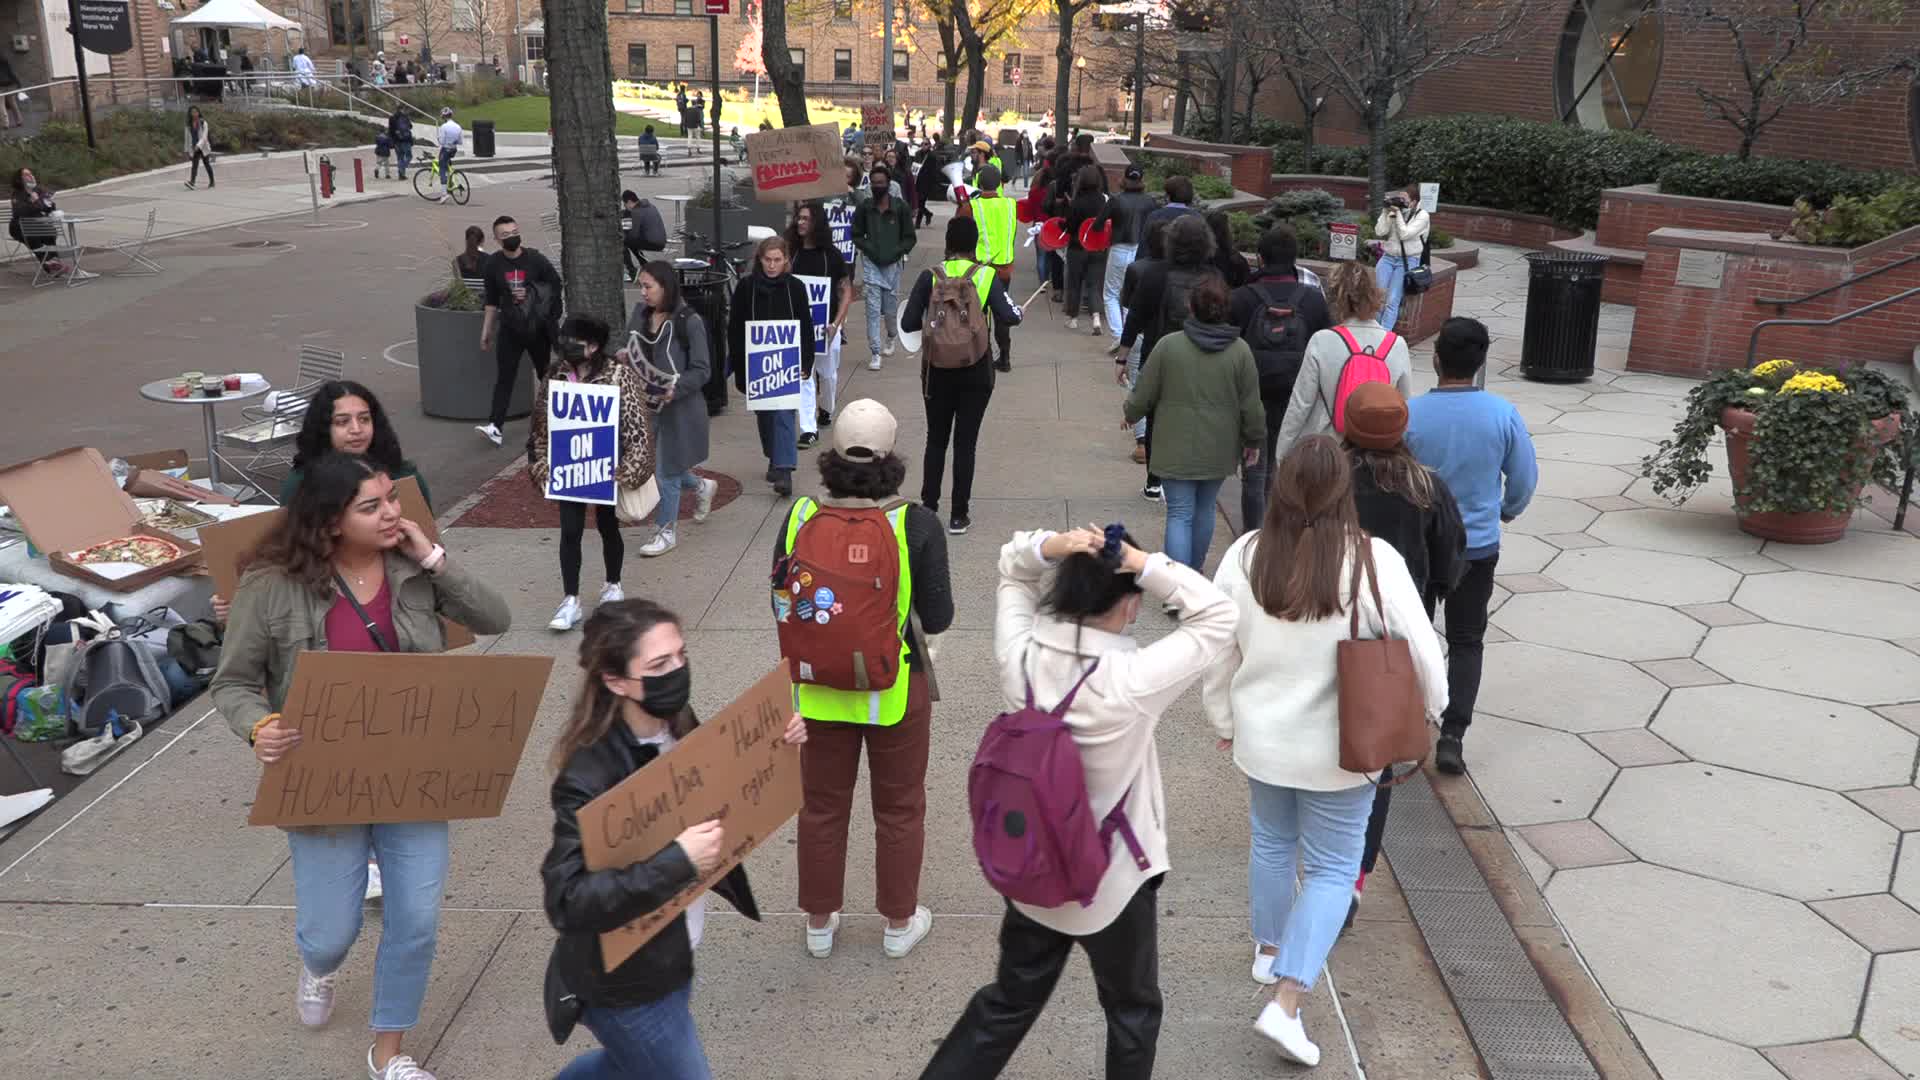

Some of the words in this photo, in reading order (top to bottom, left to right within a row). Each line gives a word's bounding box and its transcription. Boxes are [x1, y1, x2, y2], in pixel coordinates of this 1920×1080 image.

[832, 229, 845, 241] ON
[750, 325, 796, 345] UAW
[762, 352, 783, 374] ON
[748, 364, 800, 399] STRIKE
[552, 391, 614, 423] UAW
[570, 432, 593, 461] ON
[552, 456, 612, 492] STRIKE
[299, 679, 434, 743] HEALTH
[488, 688, 518, 743] A
[277, 762, 411, 817] HUMAN
[415, 769, 514, 811] RIGHT
